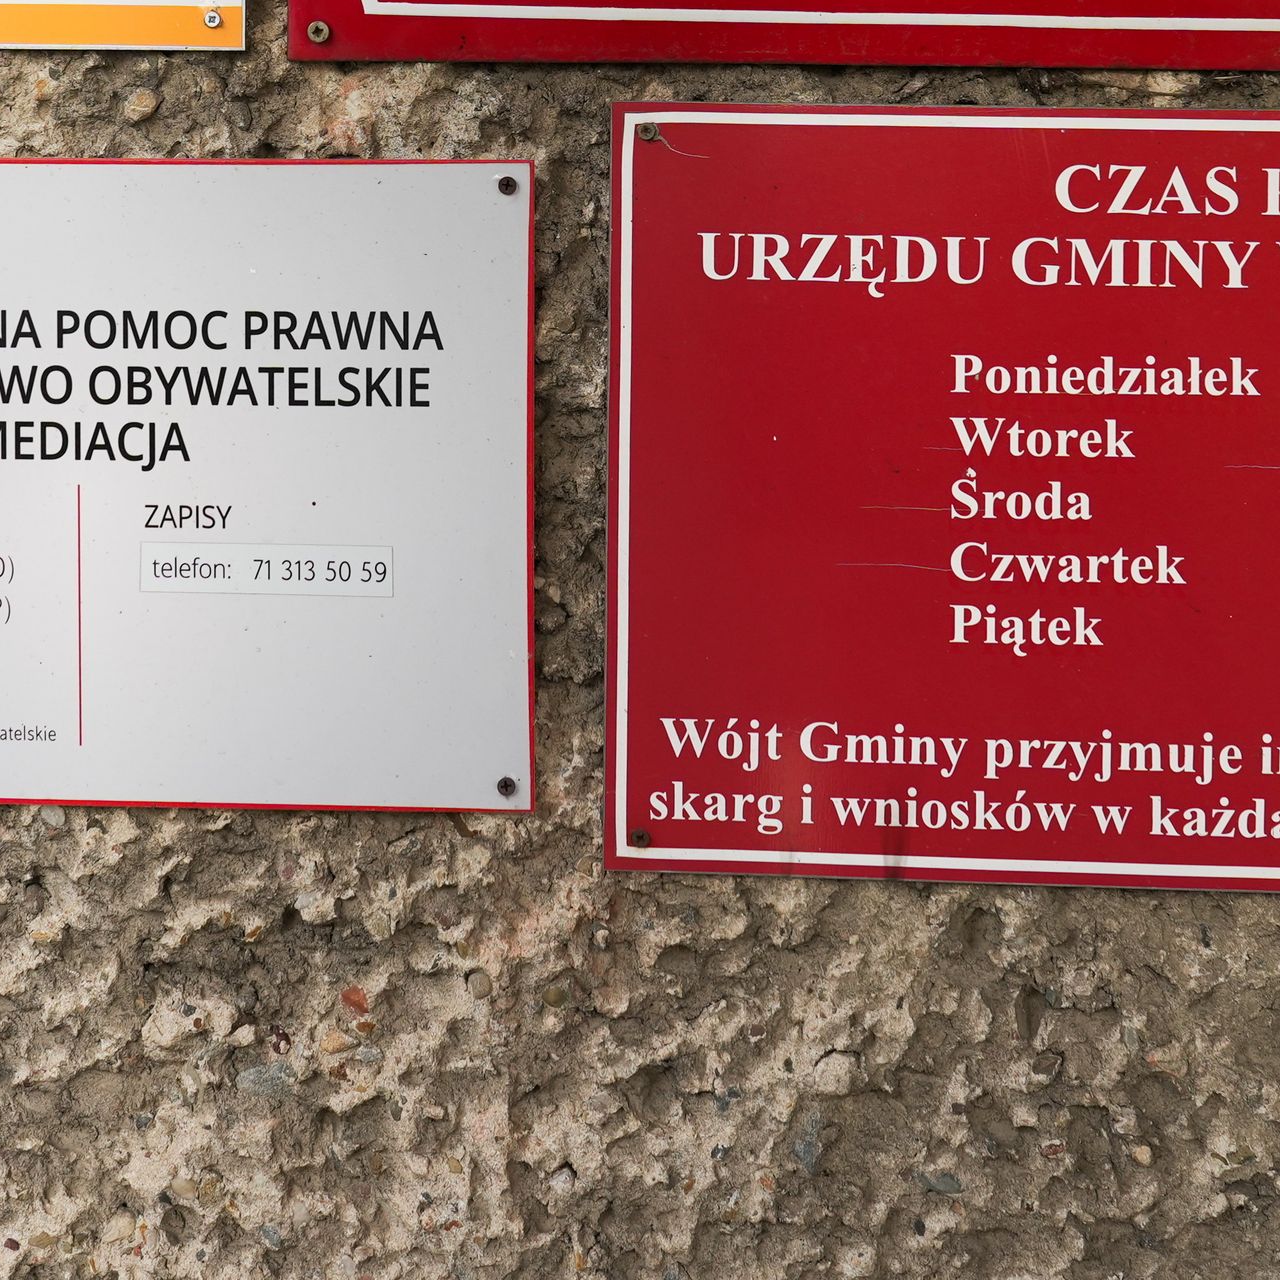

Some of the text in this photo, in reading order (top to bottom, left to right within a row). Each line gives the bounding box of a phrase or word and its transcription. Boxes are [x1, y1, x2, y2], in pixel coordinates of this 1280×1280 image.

[1054, 164, 1239, 216] CZAS
[697, 232, 991, 299] URZĘDU
[1011, 236, 1260, 289] GMINY
[56, 309, 229, 351] POMOC
[244, 310, 444, 351] PRAWNA
[88, 365, 430, 408] OBYWATELSKIE
[950, 354, 1261, 397] Poniedziałek
[949, 417, 1136, 458] Wtorek
[950, 467, 1093, 521] Środa
[144, 504, 232, 530] ZAPISY
[152, 556, 388, 584] telefon: 71 313 50 59
[950, 541, 1187, 585] Czwartek
[949, 604, 1104, 657] Piątek
[659, 717, 783, 772] Wójt
[799, 721, 968, 778] Gminy
[984, 729, 1243, 786] przyjmuje
[649, 780, 784, 835] skarg
[800, 783, 814, 825] i
[830, 786, 1077, 832] wniosków
[1091, 805, 1133, 835] w
